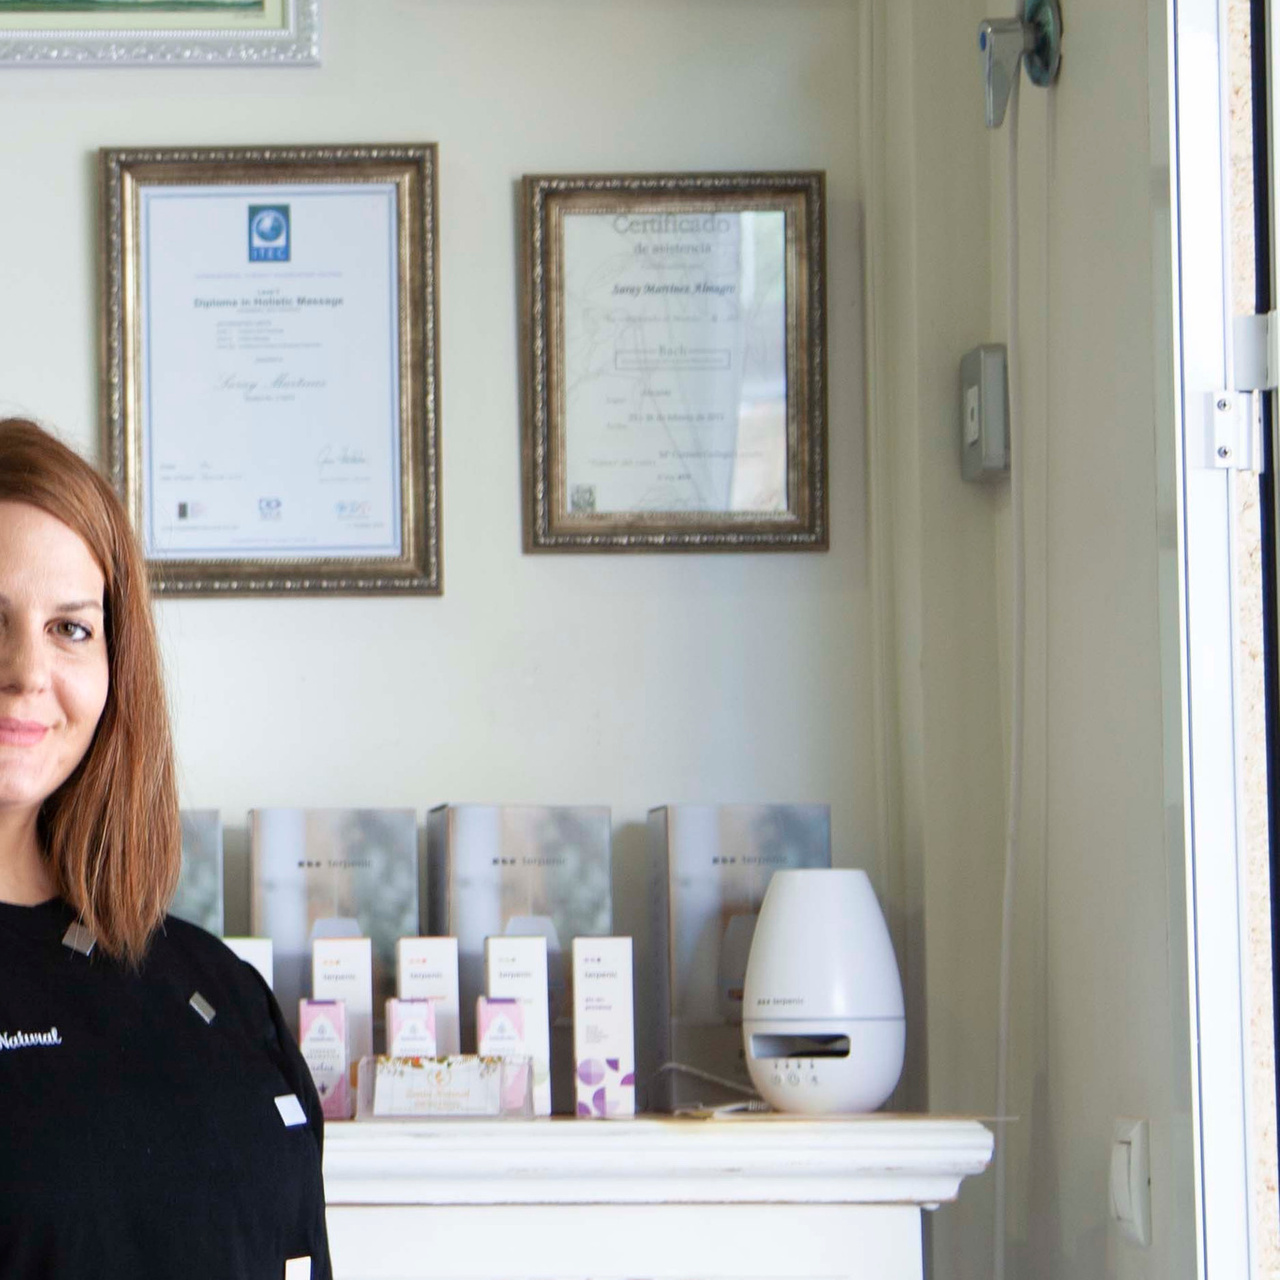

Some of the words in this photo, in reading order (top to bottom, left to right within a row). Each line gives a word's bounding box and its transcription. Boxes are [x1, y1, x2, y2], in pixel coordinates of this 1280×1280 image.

[612, 214, 732, 236] Certificado
[633, 243, 650, 255] de
[651, 242, 713, 255] asistencia
[193, 297, 239, 310] Diploma
